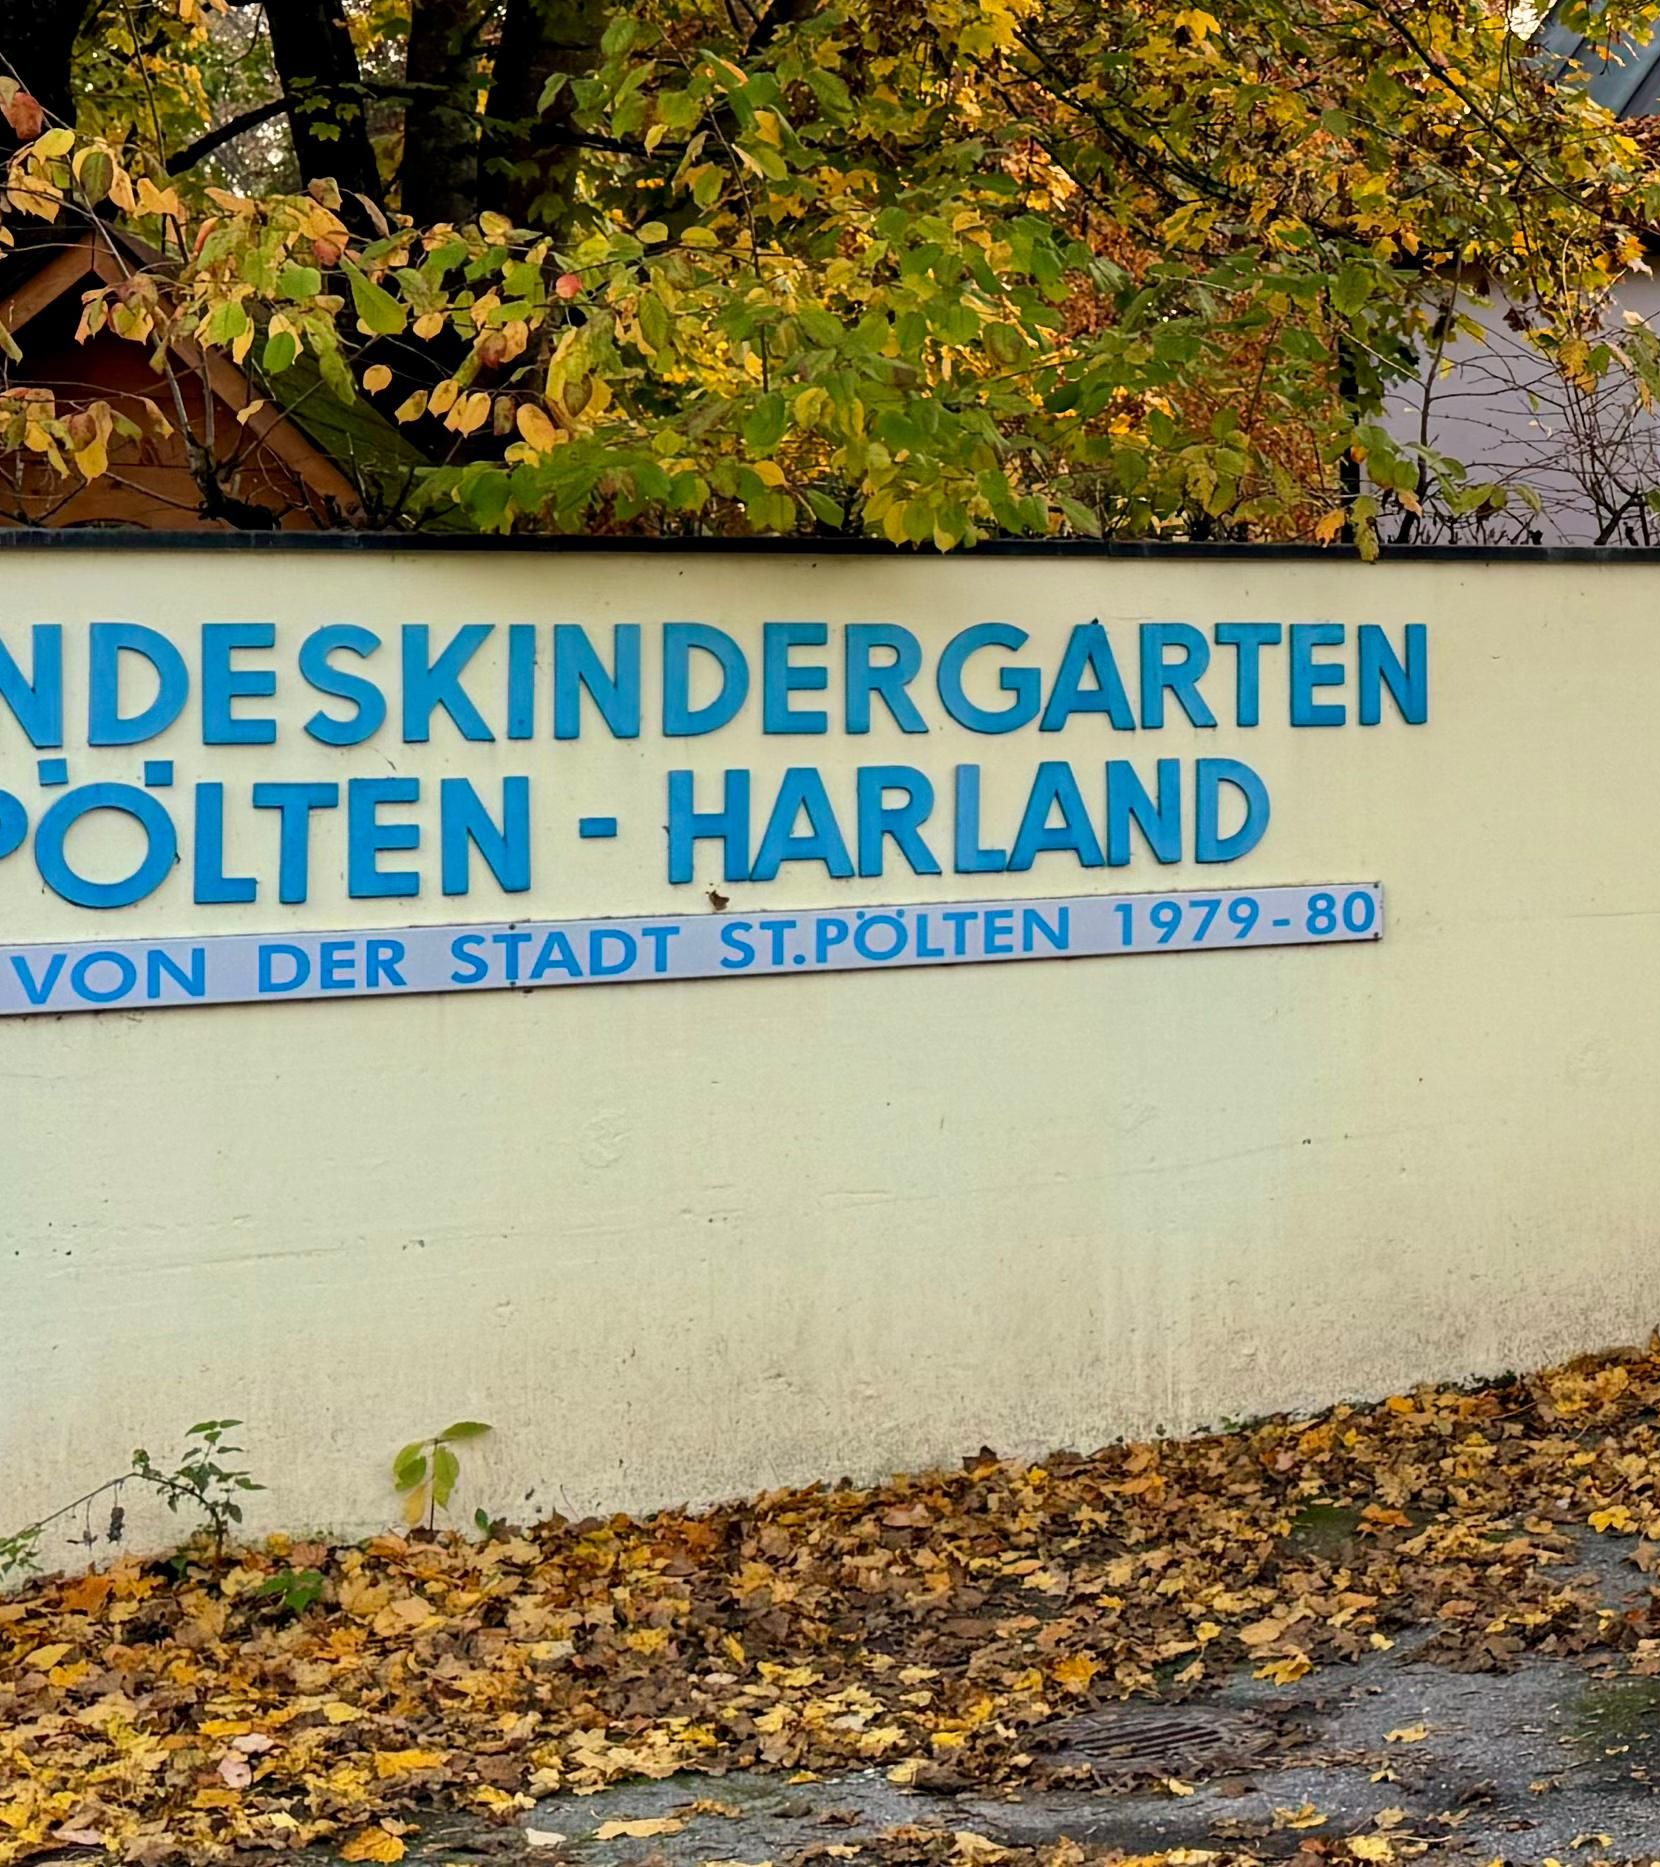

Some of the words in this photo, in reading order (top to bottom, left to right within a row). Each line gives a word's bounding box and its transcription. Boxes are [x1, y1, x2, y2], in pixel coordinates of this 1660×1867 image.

[0, 621, 1429, 750] NDESKINDERGARTEN
[579, 815, 619, 839] -
[667, 757, 1271, 886] HARLAND
[10, 946, 207, 1006] VON
[257, 938, 408, 993] DER
[450, 925, 682, 986] STADT
[719, 906, 1070, 969] ST.PÖLTEN
[1114, 890, 1376, 948] 1979-80
